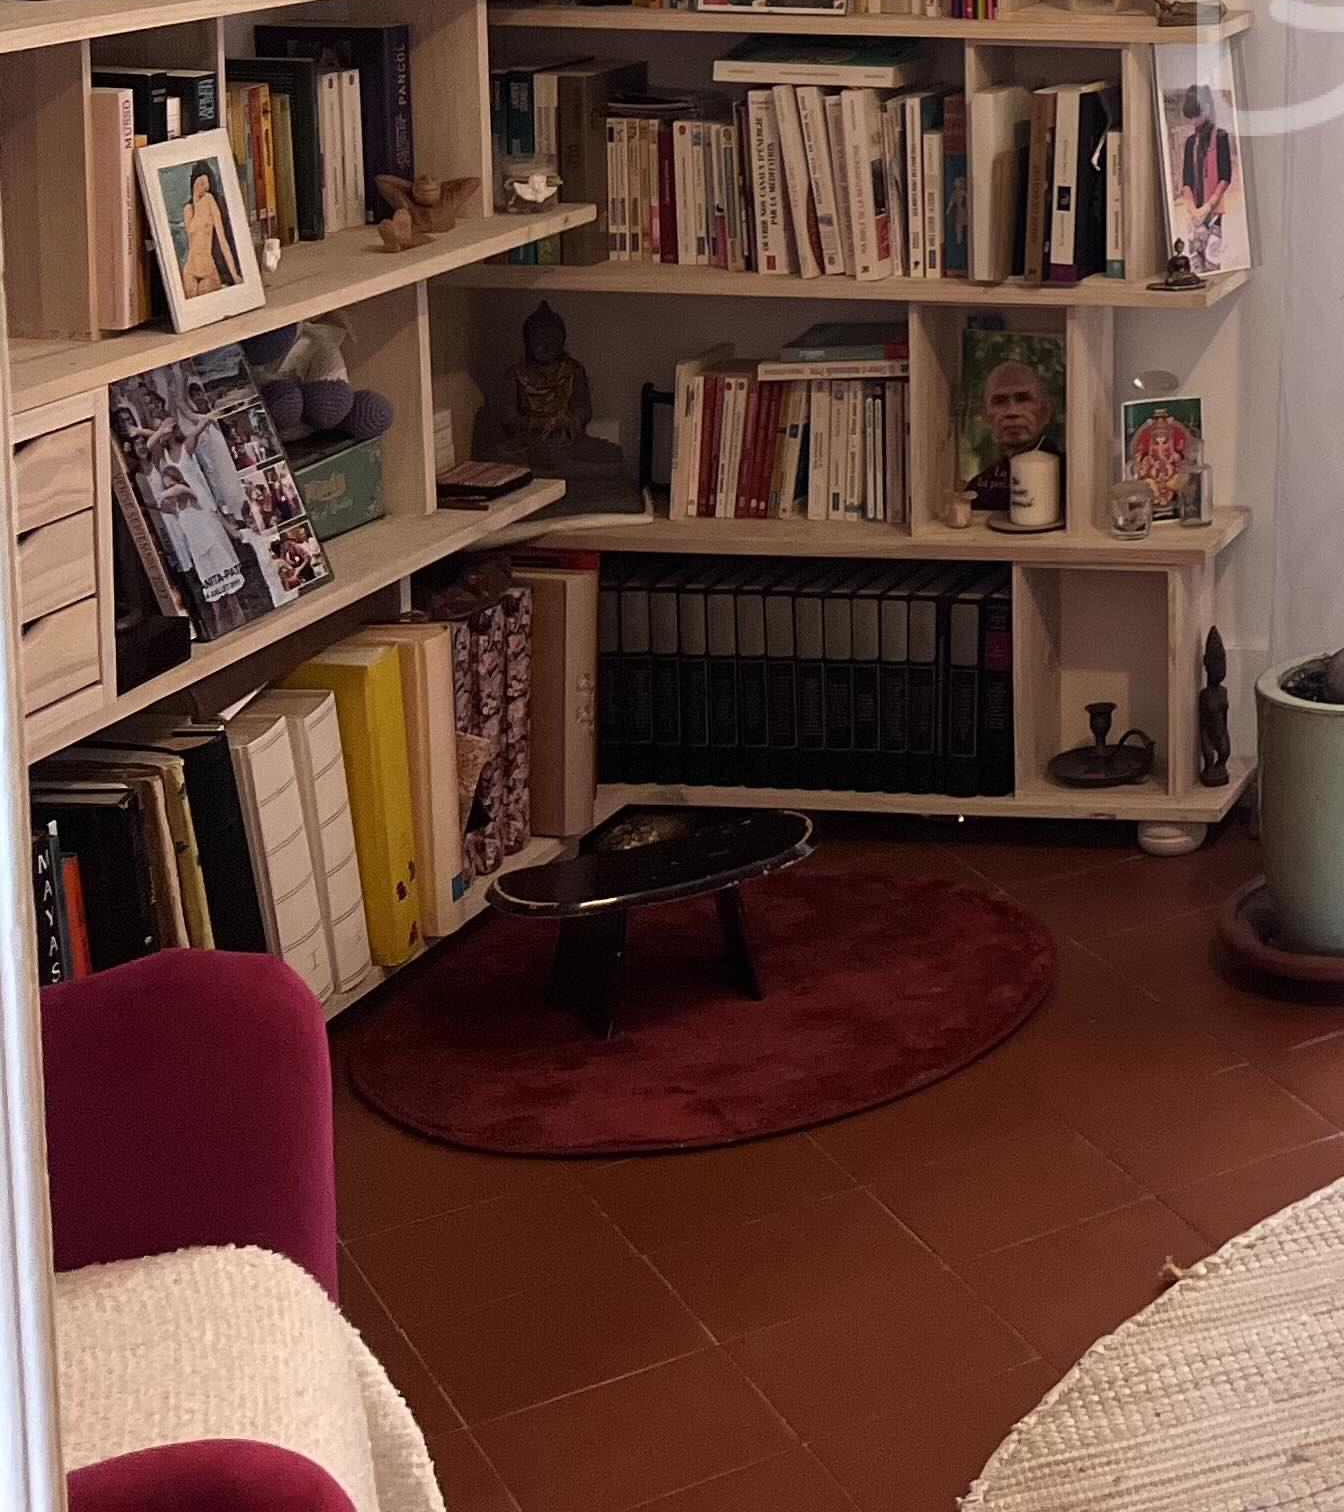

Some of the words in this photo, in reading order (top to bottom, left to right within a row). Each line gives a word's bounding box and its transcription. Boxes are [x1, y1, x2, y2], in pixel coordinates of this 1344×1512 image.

[395, 40, 408, 105] PANCOL
[206, 79, 216, 120] OLSEN
[122, 99, 133, 150] MUSSO
[758, 164, 767, 199] CANAUX
[759, 200, 768, 217] NOS
[769, 195, 777, 208] LA
[769, 208, 778, 226] PAR
[759, 219, 770, 252] OUVRIR
[127, 511, 158, 570] SEPTEMBRE
[38, 848, 61, 983] MAYAS
